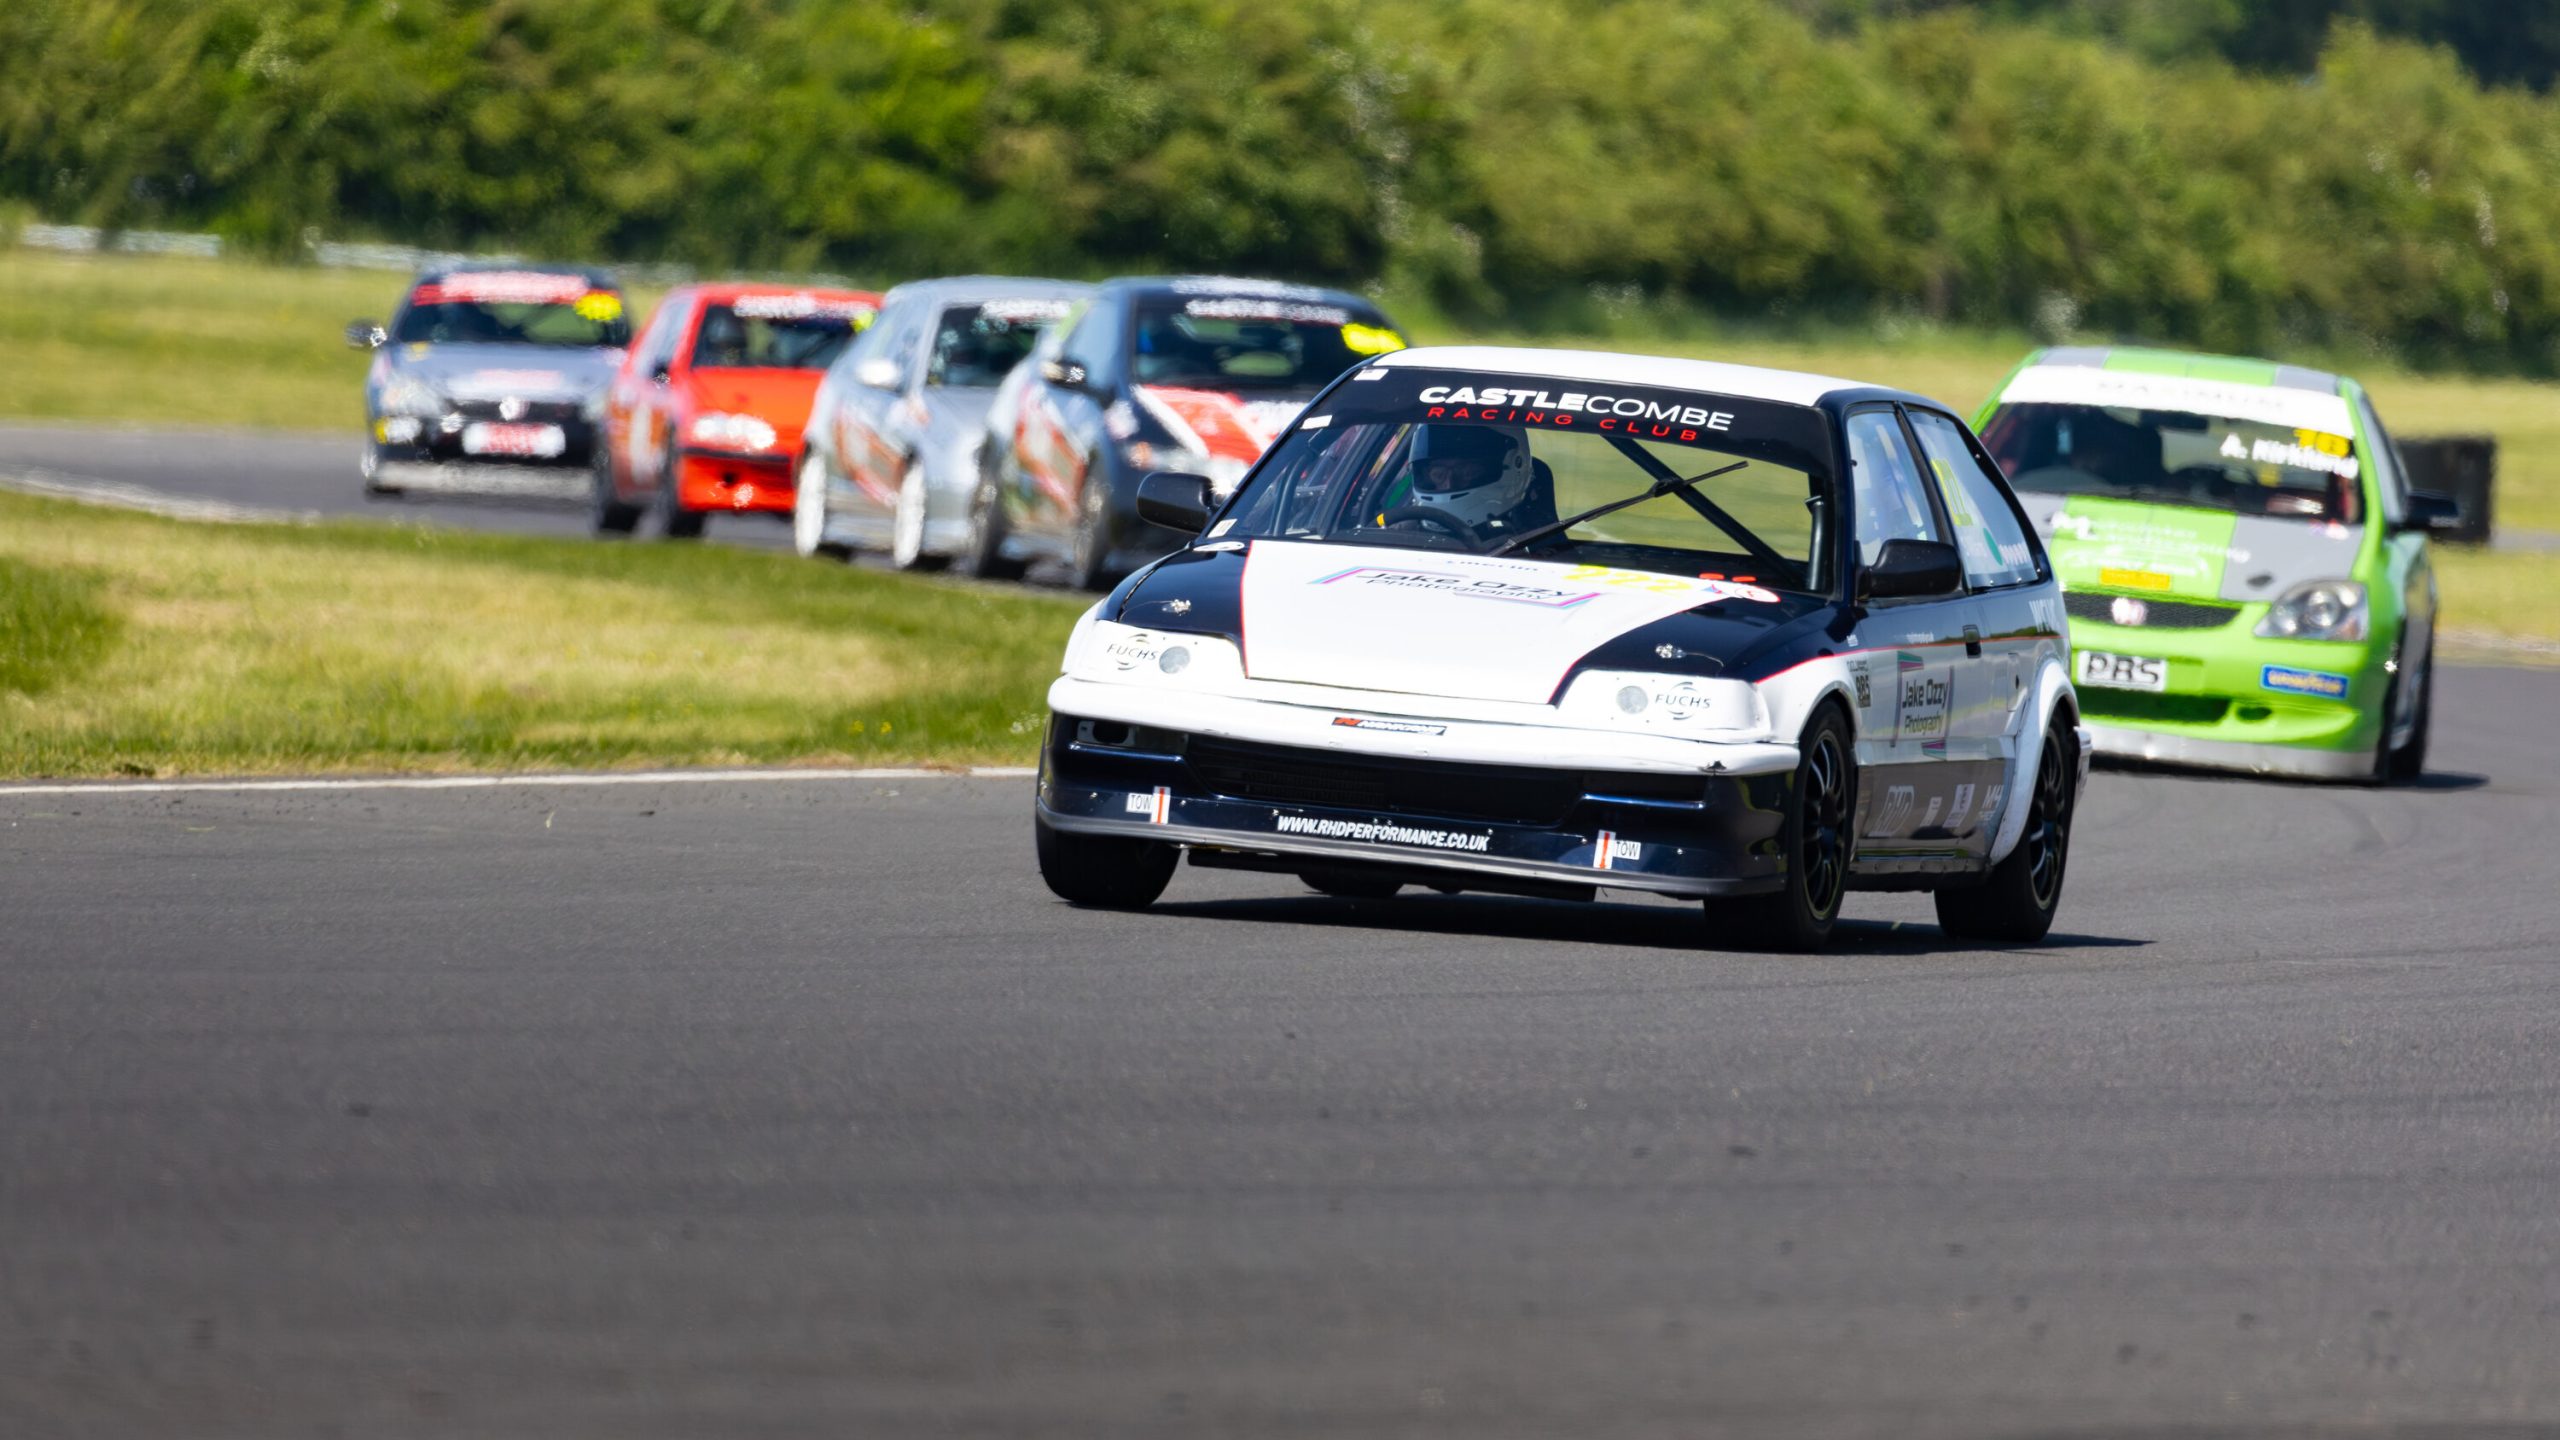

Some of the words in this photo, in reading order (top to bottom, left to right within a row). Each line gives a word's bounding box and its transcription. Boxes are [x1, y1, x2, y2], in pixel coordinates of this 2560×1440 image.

[1426, 407, 1573, 425] RACING
[1599, 418, 1698, 442] CLUB
[1356, 572, 1461, 584] Jake
[1474, 580, 1578, 597] Ozzy
[1107, 643, 1159, 661] FUCHS
[2086, 654, 2161, 686] PRS
[1654, 693, 1712, 709] FUCHS
[1902, 679, 1924, 709] Jake
[1926, 678, 1949, 710] Ozzy
[1904, 711, 1944, 735] Photography
[1130, 794, 1151, 810] TOW
[1277, 815, 1490, 851] WWW.RHDPERFORMANCE.CO.UK
[1615, 841, 1639, 857] TOW
